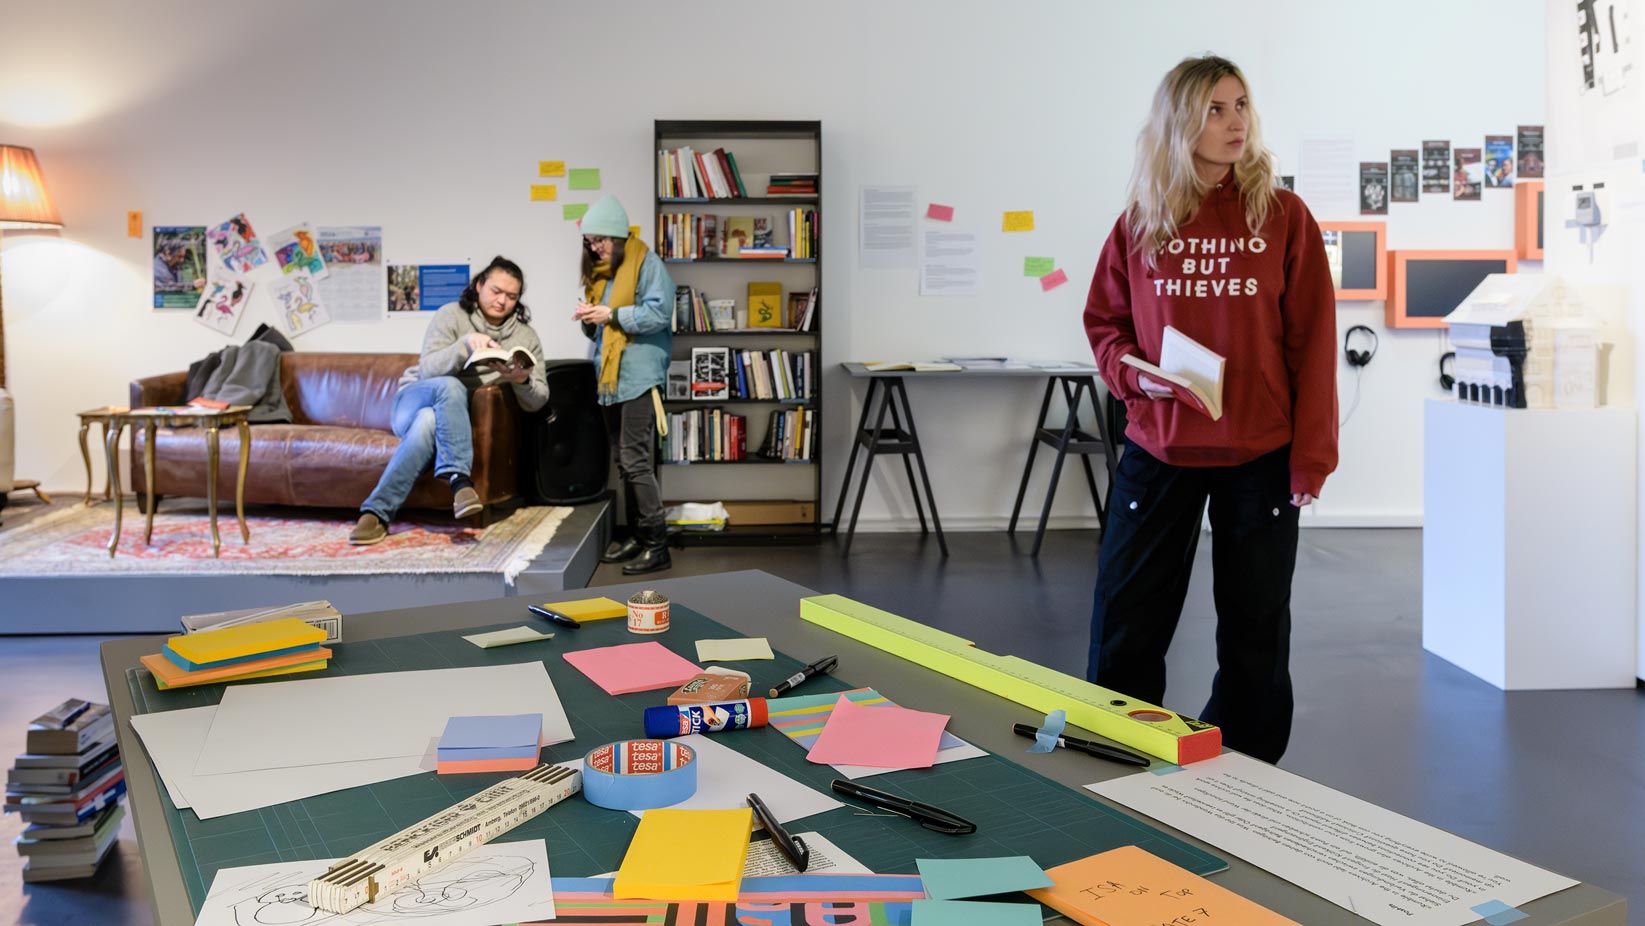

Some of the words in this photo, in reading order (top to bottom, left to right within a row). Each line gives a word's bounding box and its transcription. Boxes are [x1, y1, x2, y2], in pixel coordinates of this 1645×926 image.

[1182, 257, 1231, 276] BUT
[1154, 277, 1259, 298] THIEVES
[691, 710, 701, 735] TICK
[632, 742, 659, 752] tesa
[632, 752, 659, 762] tesa
[632, 762, 659, 772] tesa
[456, 823, 481, 843] SCHMIDT
